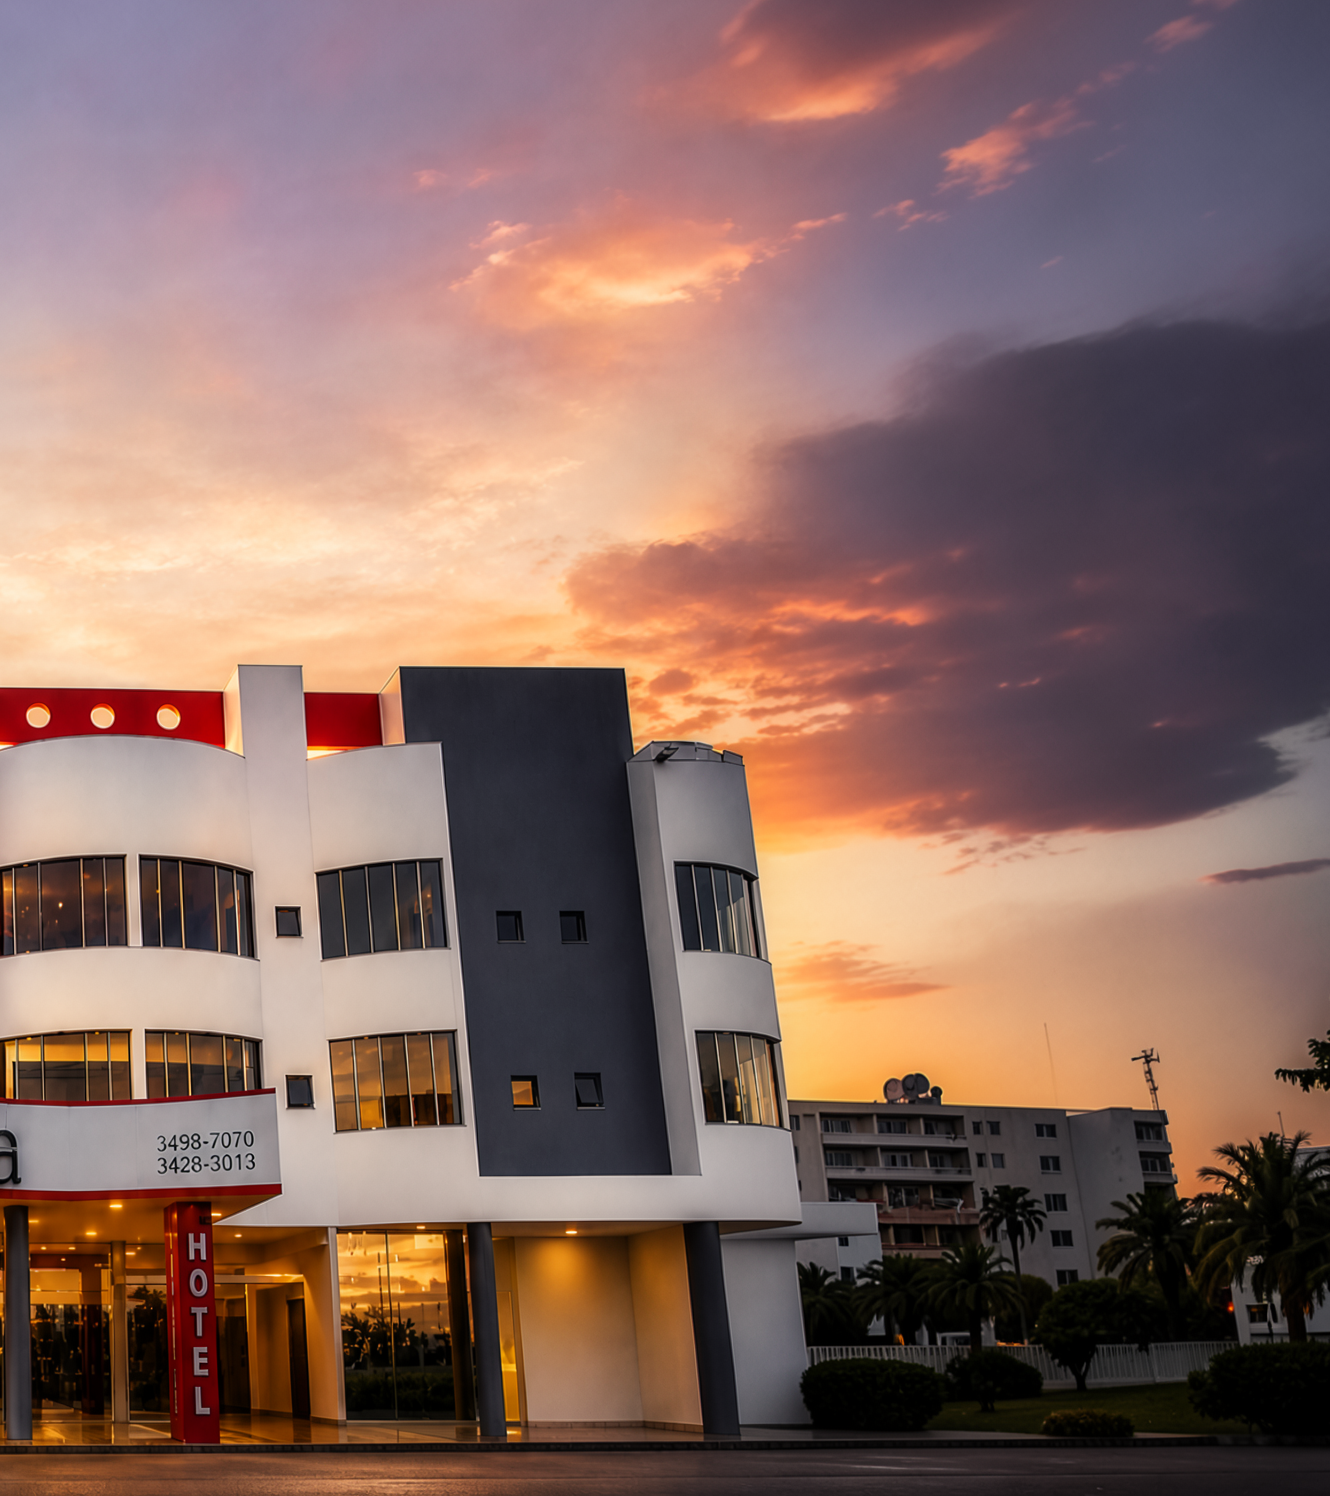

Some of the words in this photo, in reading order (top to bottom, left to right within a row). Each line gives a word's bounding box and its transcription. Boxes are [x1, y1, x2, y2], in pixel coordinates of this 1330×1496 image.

[156, 1130, 255, 1152] 3498-7070
[156, 1153, 256, 1175] 3428-3013
[188, 1232, 211, 1415] HOTEL
